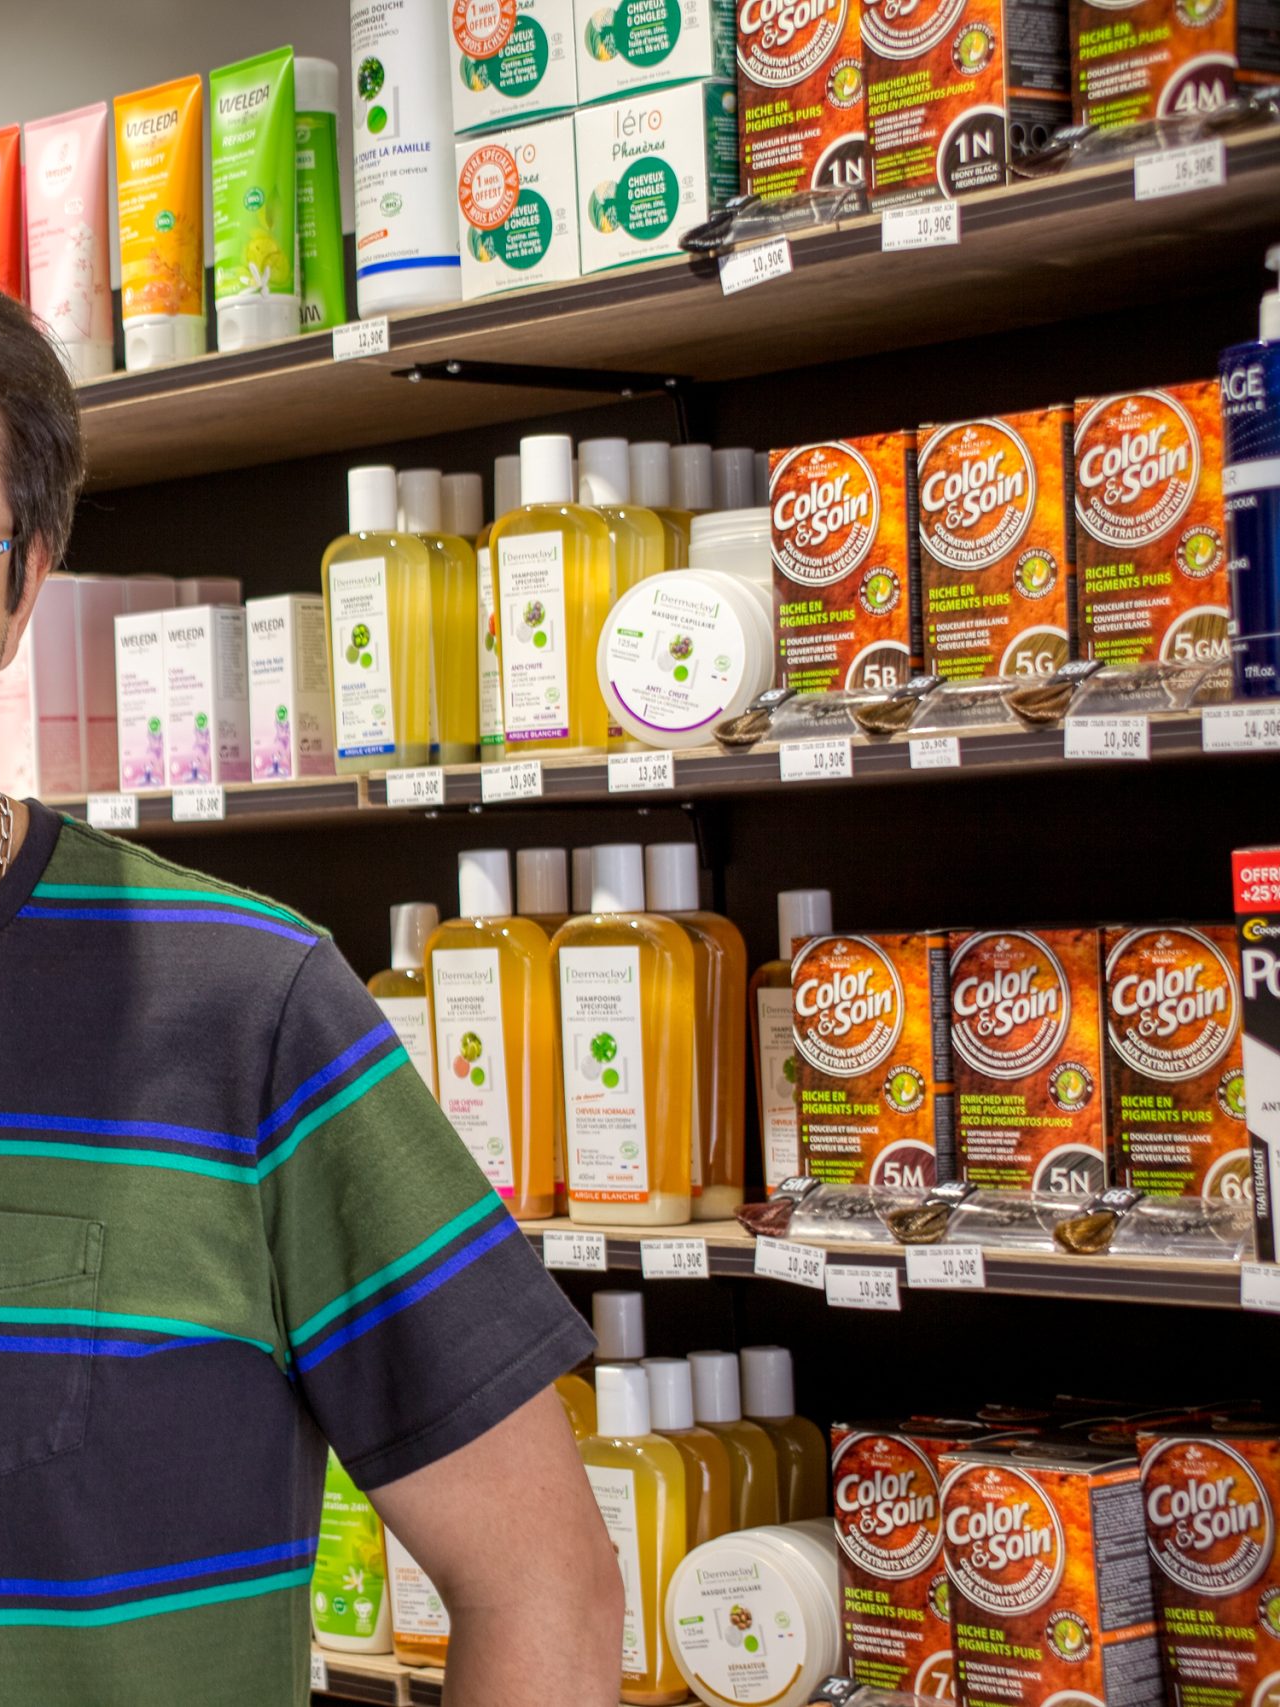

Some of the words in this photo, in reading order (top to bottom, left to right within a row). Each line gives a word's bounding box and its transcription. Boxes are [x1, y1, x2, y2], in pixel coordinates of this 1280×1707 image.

[372, 1, 404, 13] DOUCHE
[472, 5, 476, 16] 1
[479, 3, 494, 13] MOIS
[627, 0, 665, 14] CHEVEUX
[470, 16, 496, 31] OFFERT
[220, 85, 269, 114] WELEDA
[868, 90, 893, 106] PURE
[894, 81, 932, 101] PIGMENTS
[1174, 78, 1226, 113] 4M
[126, 110, 178, 138] WELEDA
[616, 109, 662, 139] léro
[745, 113, 795, 134] PIGMENTS
[797, 105, 822, 124] PURS
[223, 130, 256, 148] REFRESH
[955, 131, 994, 163] 1N
[380, 148, 389, 157] LA
[393, 142, 431, 155] FAMILLE
[612, 140, 665, 161] Phanères
[131, 154, 165, 171] VITALITY
[477, 176, 481, 187] 1
[483, 174, 499, 185] MOIS
[628, 170, 665, 188] CHEVEUX
[828, 157, 864, 189] 1N
[951, 168, 976, 181] EBONY
[977, 164, 998, 178] BLACK
[475, 186, 502, 201] OFFERT
[469, 208, 488, 223] MOIS
[917, 215, 952, 236] 10,90€
[753, 248, 784, 273] 10,90€
[359, 330, 383, 348] 12,90€
[1079, 424, 1167, 488] Color
[922, 451, 1004, 512] Color
[773, 472, 850, 531] Color
[1085, 508, 1103, 529] AUX
[1102, 523, 1148, 539] EXTRAITS
[1148, 481, 1189, 530] VÉGÉTAUX
[1090, 496, 1134, 526] COLORATION
[1136, 477, 1178, 524] PERMANENTE
[930, 534, 945, 553] AUX
[946, 548, 987, 561] EXTRAITS
[988, 510, 1023, 554] VÉGÉTAUX
[779, 550, 794, 569] AUX
[794, 564, 835, 578] EXTRAITS
[834, 525, 870, 571] VÉGÉTAUX
[1085, 565, 1117, 579] RICHE
[1119, 564, 1134, 575] EN
[928, 587, 959, 600] RICHE
[960, 584, 974, 595] EN
[1086, 576, 1140, 593] PIGMENTS
[1142, 573, 1172, 586] PURS
[660, 593, 715, 614] Dermaclay
[780, 603, 808, 615] RICHE
[809, 601, 823, 613] EN
[929, 597, 979, 613] PIGMENTS
[982, 593, 1010, 606] PURS
[1093, 603, 1124, 613] DOUCEUR
[1125, 601, 1133, 609] ET
[1134, 597, 1170, 608] BRILLANCE
[251, 618, 284, 634] WELEDA
[652, 610, 679, 622] MASQUE
[680, 616, 715, 630] CAPILLAIRE
[780, 613, 829, 628] PIGMENTS
[830, 609, 855, 622] PURS
[1094, 622, 1124, 633] CHEVEUX
[1125, 620, 1151, 630] BLANCS
[618, 637, 639, 650] 125ml
[1174, 634, 1230, 661] 5GM
[1016, 651, 1055, 677] 5G
[864, 664, 897, 690] 5B
[646, 684, 662, 694] ANTI
[668, 690, 689, 700] CHUTE
[1104, 731, 1141, 750] 10,90€
[813, 753, 845, 769] 10,90€
[510, 773, 537, 790] 10,90€
[638, 765, 668, 781] 13,90€
[413, 781, 439, 796] 10,90€
[571, 969, 627, 982] Dermaclay
[795, 968, 873, 1017] Color
[954, 965, 1037, 1016] Color
[1112, 962, 1203, 1016] Color
[977, 1008, 996, 1036] &
[993, 986, 1057, 1036] Soin
[1138, 1008, 1159, 1036] &
[1156, 985, 1225, 1036] Soin
[802, 1091, 829, 1101] RICHE
[832, 1091, 845, 1100] EN
[960, 1096, 1001, 1105] ENRICHED
[1002, 1096, 1025, 1105] WITH
[1121, 1096, 1154, 1108] RICHE
[1157, 1097, 1172, 1108] EN
[576, 1108, 601, 1116] CHEVEUX
[602, 1107, 636, 1116] NORMAUX
[802, 1104, 852, 1115] PIGMENTS
[854, 1105, 880, 1115] PURS
[960, 1105, 981, 1114] PURE
[983, 1106, 1026, 1115] PIGMENTS
[1122, 1110, 1179, 1122] PIGMENTS
[1182, 1112, 1213, 1122] PURS
[960, 1116, 979, 1125] RICO
[980, 1117, 992, 1125] EN
[993, 1117, 1041, 1127] PIGMENTOS
[1043, 1118, 1072, 1128] PUROS
[1131, 1154, 1162, 1162] CHEVEUX
[1164, 1155, 1191, 1163] BLANCS
[883, 1161, 925, 1187] 5M
[1050, 1168, 1089, 1194] 5N
[1252, 1148, 1268, 1217] TRAITEMENT
[782, 1179, 806, 1190] 5M
[574, 1192, 599, 1201] ARGILE
[601, 1193, 640, 1201] BLANCHE
[572, 1245, 600, 1261] 13,90€
[672, 1253, 702, 1269] 10,90€
[788, 1257, 819, 1277] 10,90€
[943, 1261, 977, 1278] 10,90€
[859, 1282, 892, 1297] 10,90€
[836, 1470, 915, 1512] Color
[1148, 1476, 1234, 1526] Color
[860, 1507, 878, 1533] &
[875, 1492, 934, 1536] Soin
[946, 1502, 1030, 1545] Color
[1175, 1520, 1195, 1548] &
[1192, 1499, 1258, 1550] Soin
[971, 1540, 990, 1568] &
[988, 1525, 1051, 1570] Soin
[702, 1567, 754, 1581] Dermaclay
[701, 1588, 726, 1597] MASQUE
[728, 1585, 762, 1593] CAPILLAIRE
[957, 1623, 988, 1639] RICHE
[990, 1629, 1004, 1642] EN
[958, 1637, 1011, 1656] PIGMENTS
[1013, 1646, 1043, 1661] PURS
[823, 1678, 849, 1695] 7C
